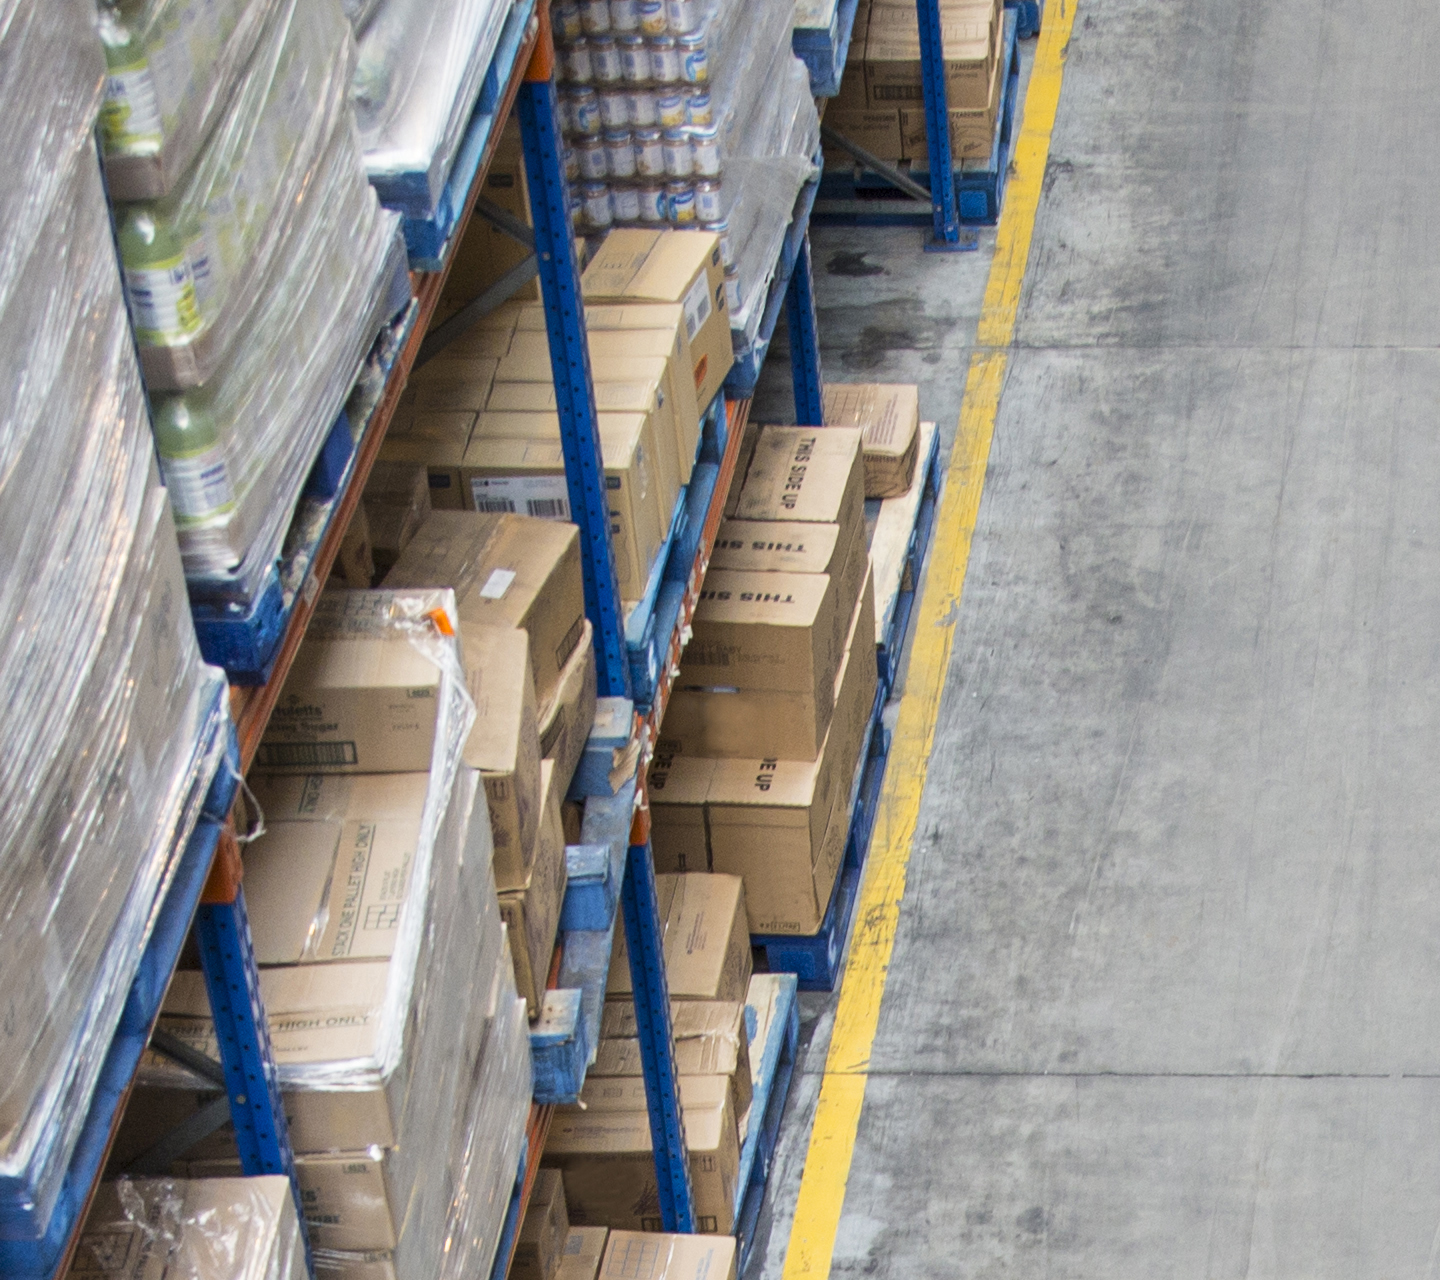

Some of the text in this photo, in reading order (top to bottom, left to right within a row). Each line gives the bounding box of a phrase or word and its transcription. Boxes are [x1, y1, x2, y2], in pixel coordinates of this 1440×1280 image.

[779, 437, 817, 510] THIS SIDE UP
[751, 541, 807, 553] THIS
[740, 590, 795, 603] THIS
[754, 774, 773, 791] UP
